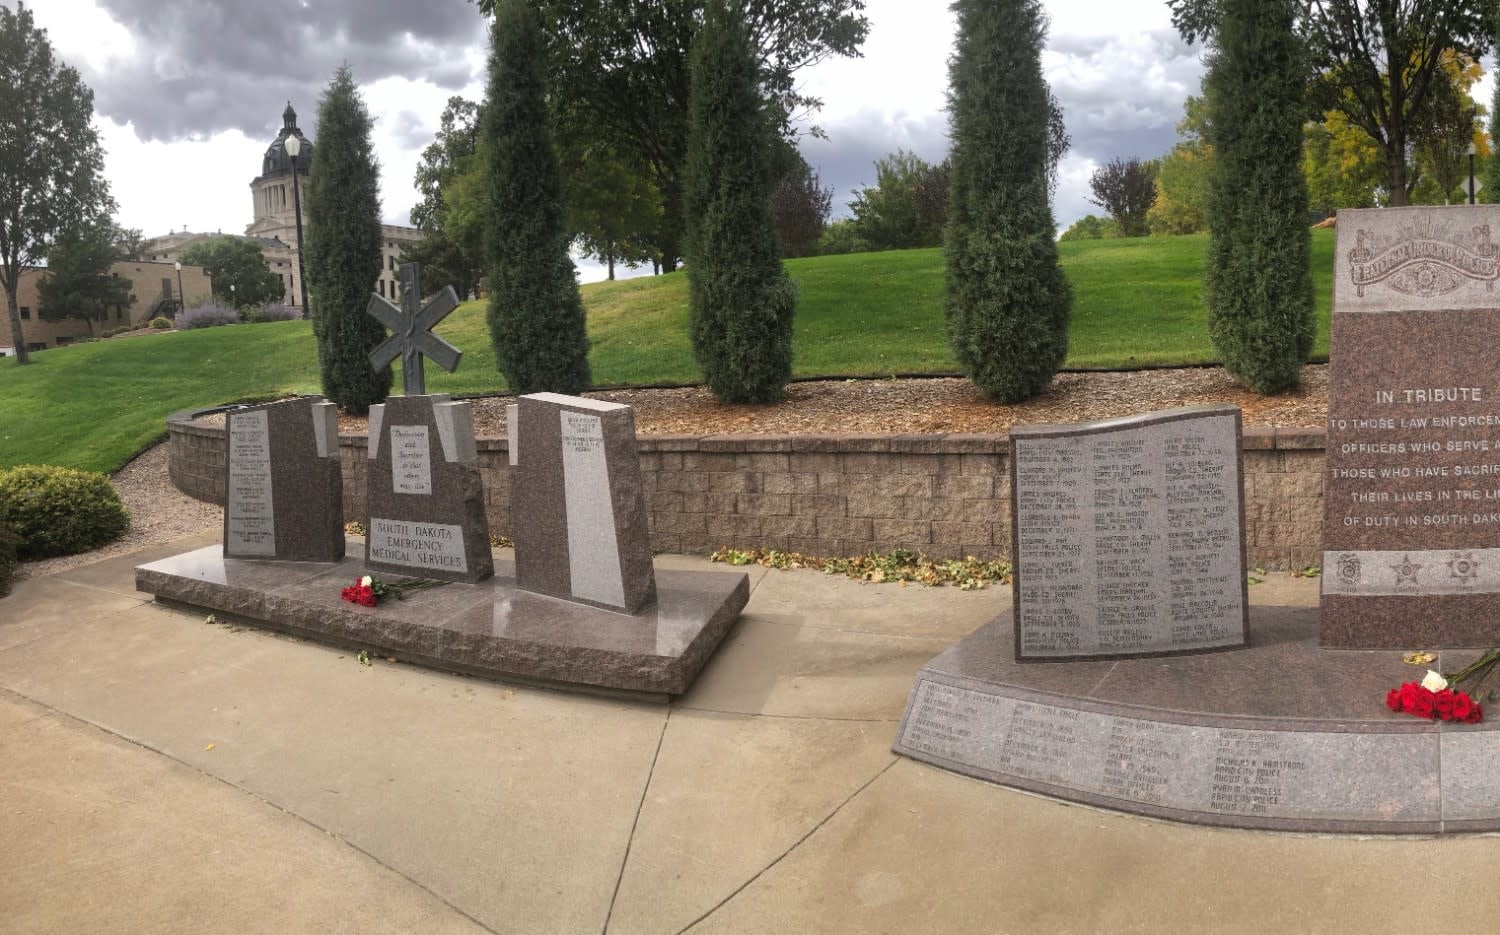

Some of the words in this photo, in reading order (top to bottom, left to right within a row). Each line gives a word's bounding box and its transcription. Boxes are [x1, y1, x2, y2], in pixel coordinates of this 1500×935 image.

[1375, 390, 1394, 404] IN
[1404, 387, 1483, 404] TRIBUTE
[1330, 419, 1347, 430] TO
[1352, 418, 1395, 429] THOSE
[1400, 417, 1428, 429] LAW
[1341, 442, 1406, 454] OFFICERS
[1411, 441, 1441, 452] WHO
[1446, 440, 1489, 451] SERVE
[1332, 468, 1376, 479] THOSE
[1380, 467, 1410, 478] WHO
[1415, 465, 1449, 477] HAVE
[1351, 491, 1389, 503] THEIR
[1394, 490, 1432, 501] LIVES
[1438, 490, 1450, 500] IN
[1455, 489, 1481, 500] THE
[1343, 516, 1361, 527] OF
[1365, 515, 1399, 526] DUTY
[1405, 515, 1419, 526] IN
[1423, 514, 1468, 526] SOUTH
[376, 522, 408, 535] SOUTH
[415, 526, 453, 539] DAKOTA
[387, 536, 444, 551] EMERGENCY
[372, 547, 410, 561] MEDICAL
[417, 553, 462, 567] SERVICES
[1215, 765, 1236, 775] RAPID
[1237, 767, 1255, 776] CITY
[1256, 768, 1281, 777] POLICE
[1262, 760, 1306, 770] ARMSTRONG
[1214, 773, 1240, 783] AUGUST
[1212, 783, 1233, 793] RYAN
[1211, 793, 1232, 802] RAPID
[1234, 795, 1252, 804] CITY
[1253, 796, 1279, 805] POLICE
[1210, 801, 1237, 811] AUGUST
